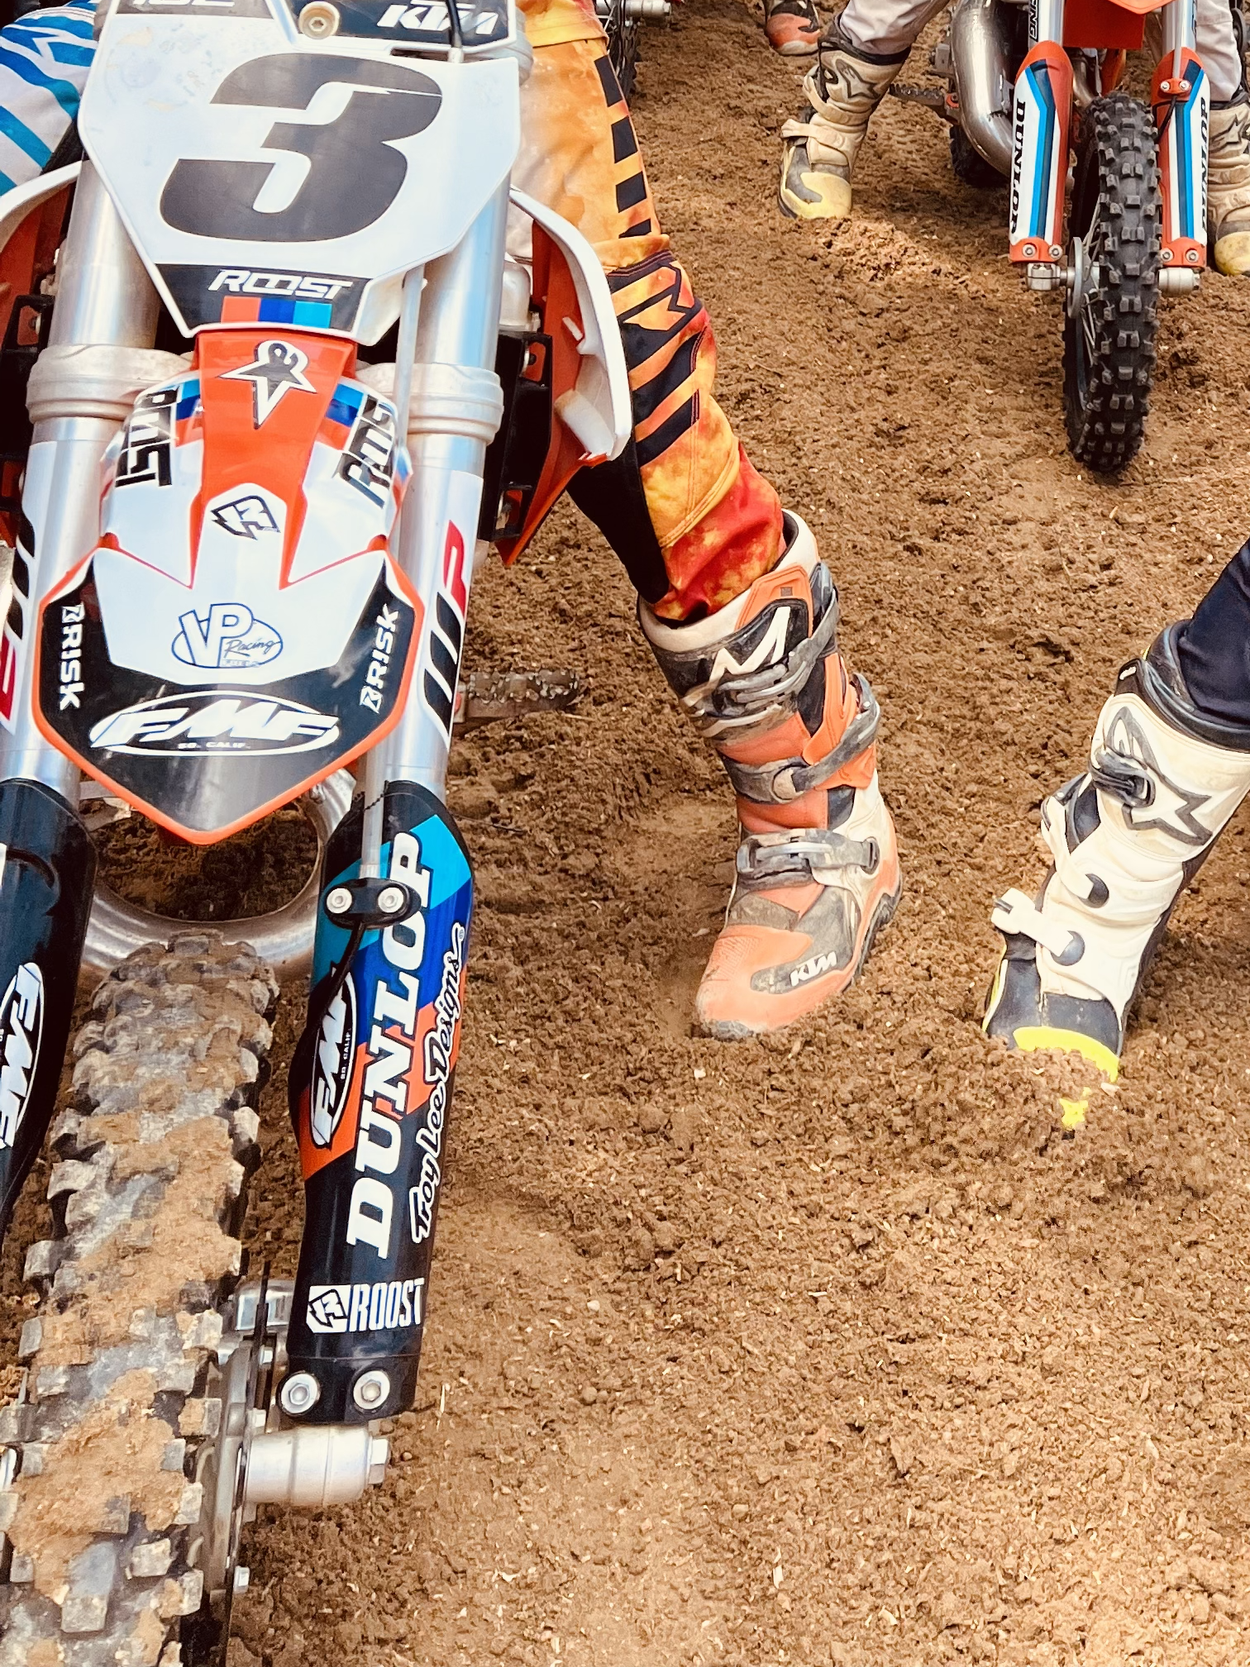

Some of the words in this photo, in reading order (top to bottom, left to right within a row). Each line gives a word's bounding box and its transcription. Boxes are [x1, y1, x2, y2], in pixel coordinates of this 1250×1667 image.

[376, 0, 500, 36] KTM
[159, 52, 443, 243] 3
[1009, 97, 1027, 235] DUNLOP
[207, 269, 354, 302] ROOST
[59, 604, 86, 710] BRISK
[178, 602, 254, 668] VP
[223, 637, 281, 657] Racing
[358, 606, 400, 713] BRISK
[90, 698, 340, 748] FMF
[789, 950, 839, 987] KTM
[345, 830, 436, 1260] DUNLOP
[416, 1080, 446, 1158] Lee
[407, 1155, 441, 1243] Troy
[347, 1276, 426, 1332] ROOST
